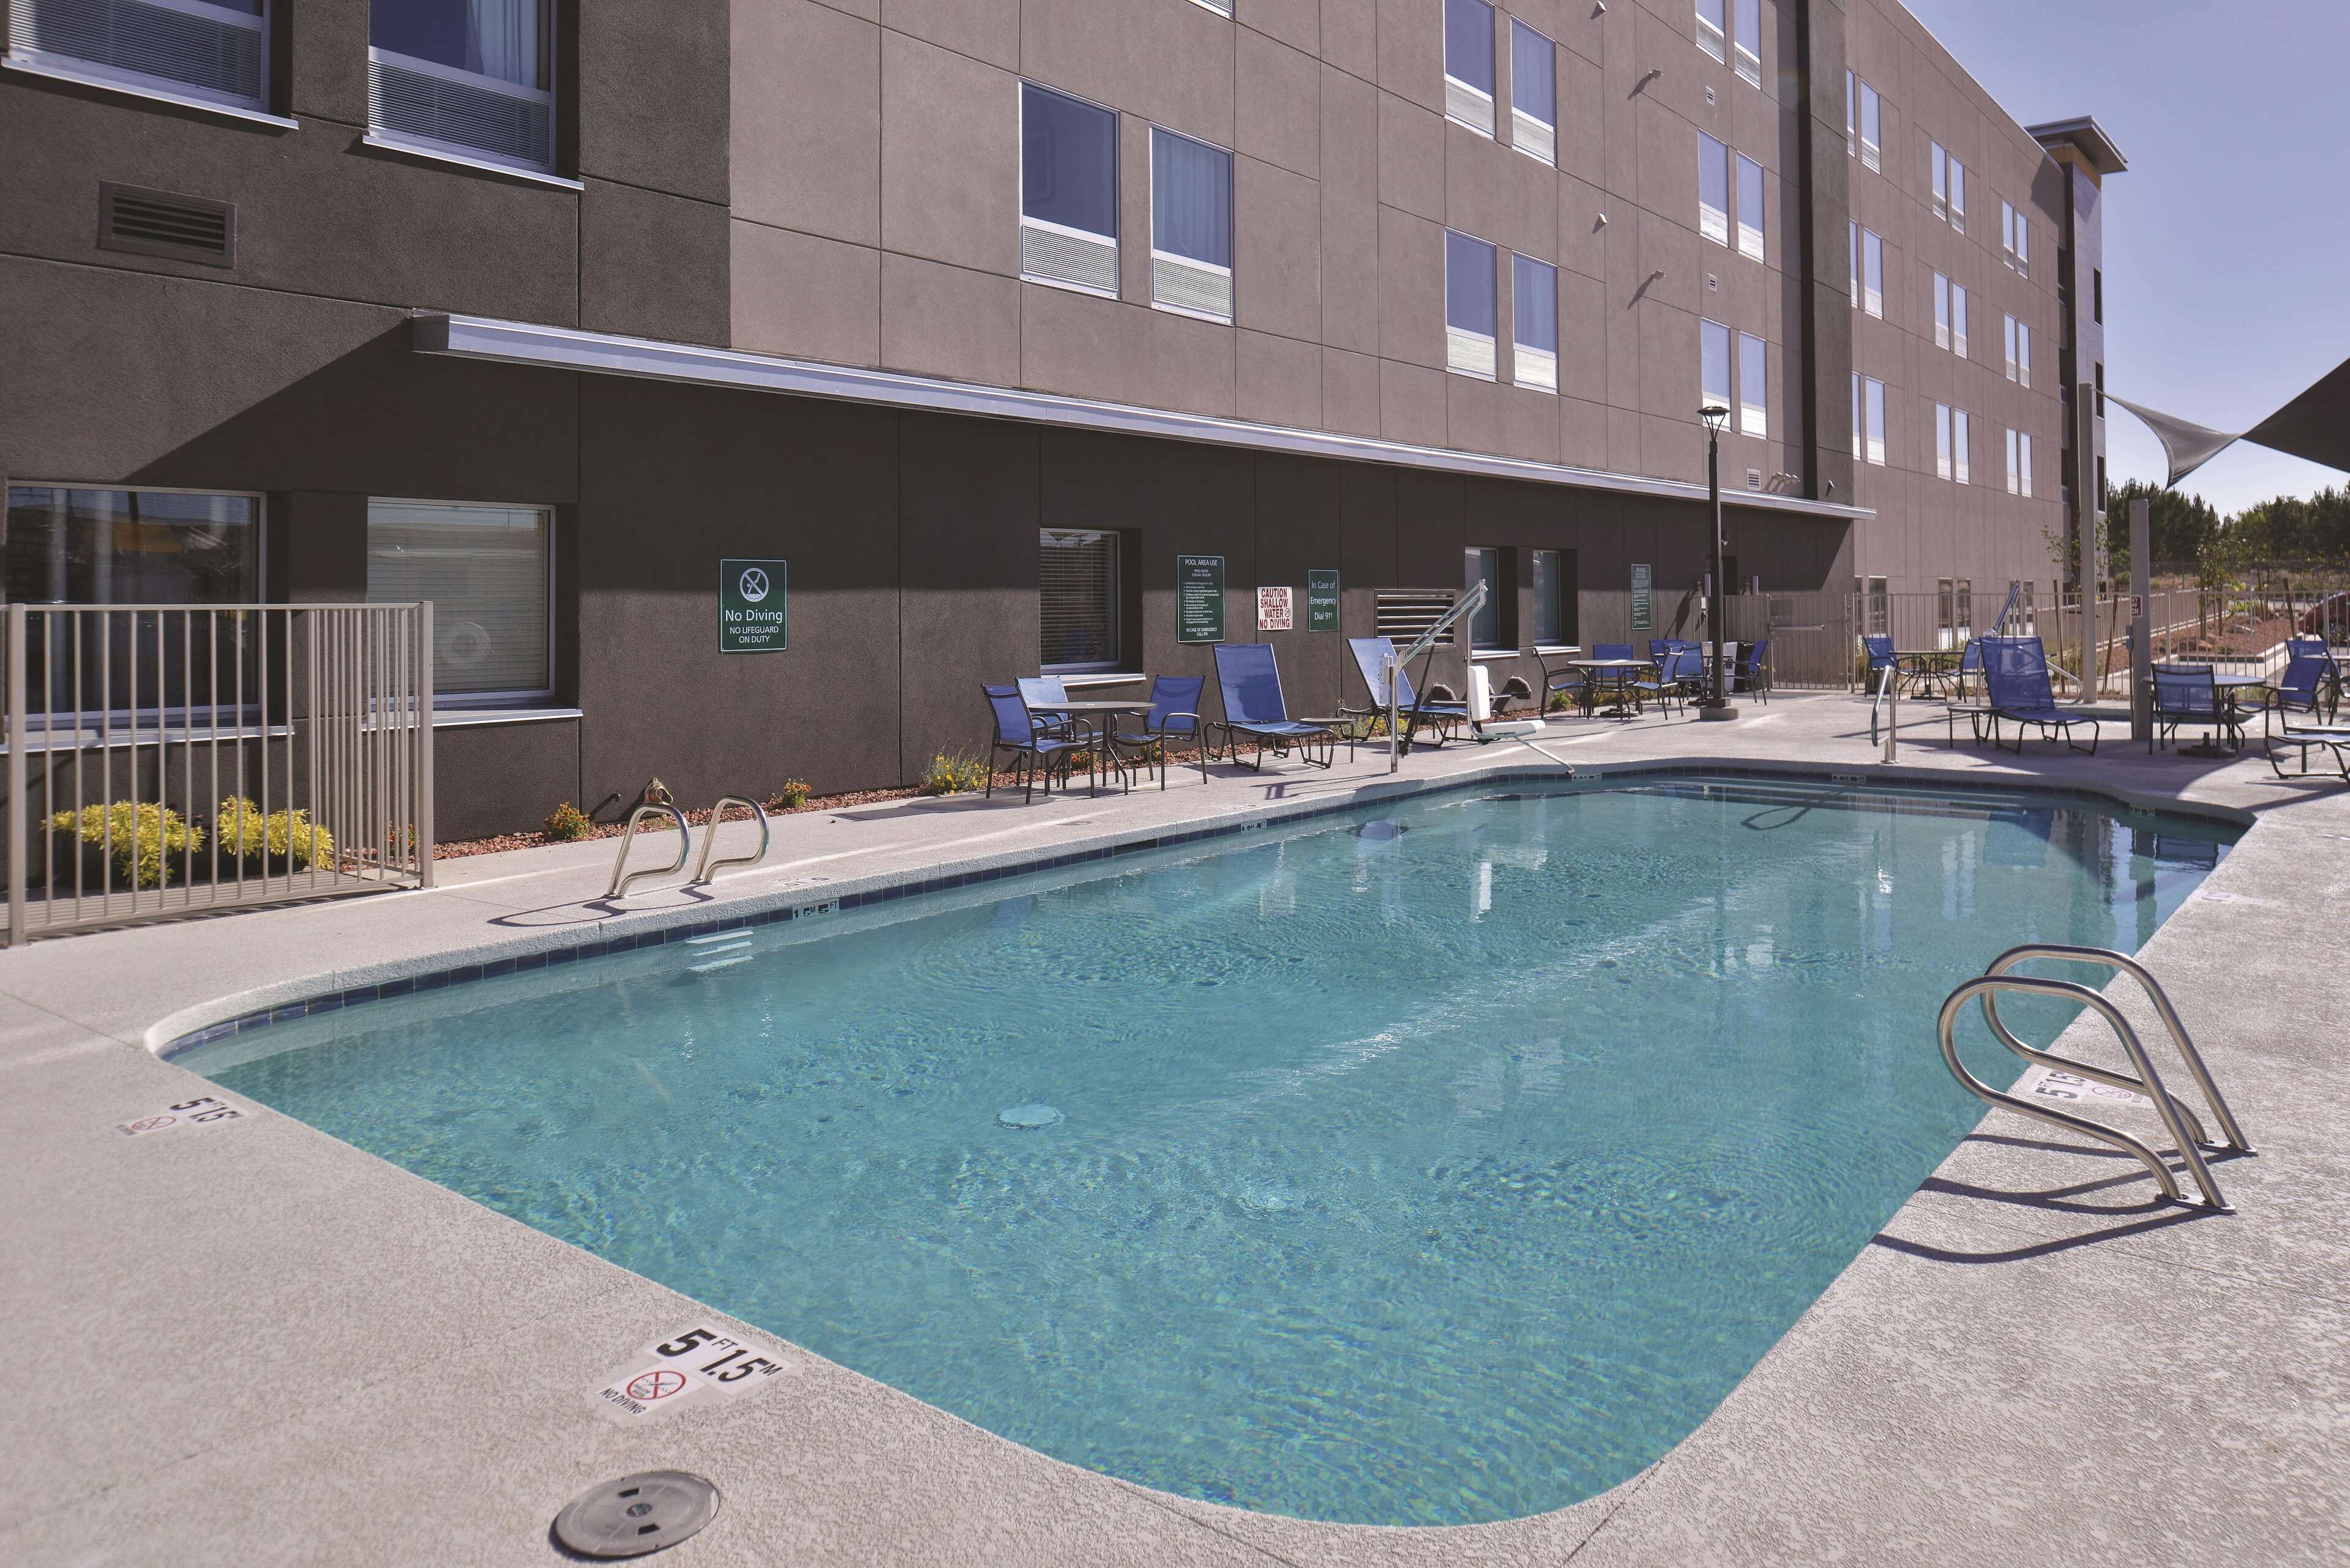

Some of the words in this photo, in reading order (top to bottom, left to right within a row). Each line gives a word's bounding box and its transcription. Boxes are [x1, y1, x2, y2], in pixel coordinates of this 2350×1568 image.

[1330, 580, 1336, 589] of
[1261, 588, 1287, 598] CAUTION
[1260, 598, 1288, 608] SHALLOW
[1311, 597, 1336, 607] Emergency
[725, 610, 742, 621] No
[746, 609, 782, 624] Diving
[1264, 609, 1284, 619] WATER
[1314, 611, 1324, 620] Dial
[1259, 619, 1268, 630] NO
[1270, 618, 1290, 629] DIVING
[818, 903, 829, 913] 5
[830, 901, 837, 909] FT
[2035, 1086, 2078, 1099] 5
[169, 1097, 214, 1111] 5
[656, 1328, 717, 1357] 5
[711, 1337, 739, 1351] FT
[699, 1350, 770, 1383] 1.5
[759, 1364, 784, 1376] M
[599, 1387, 618, 1400] NO
[612, 1394, 647, 1414] DIVING
